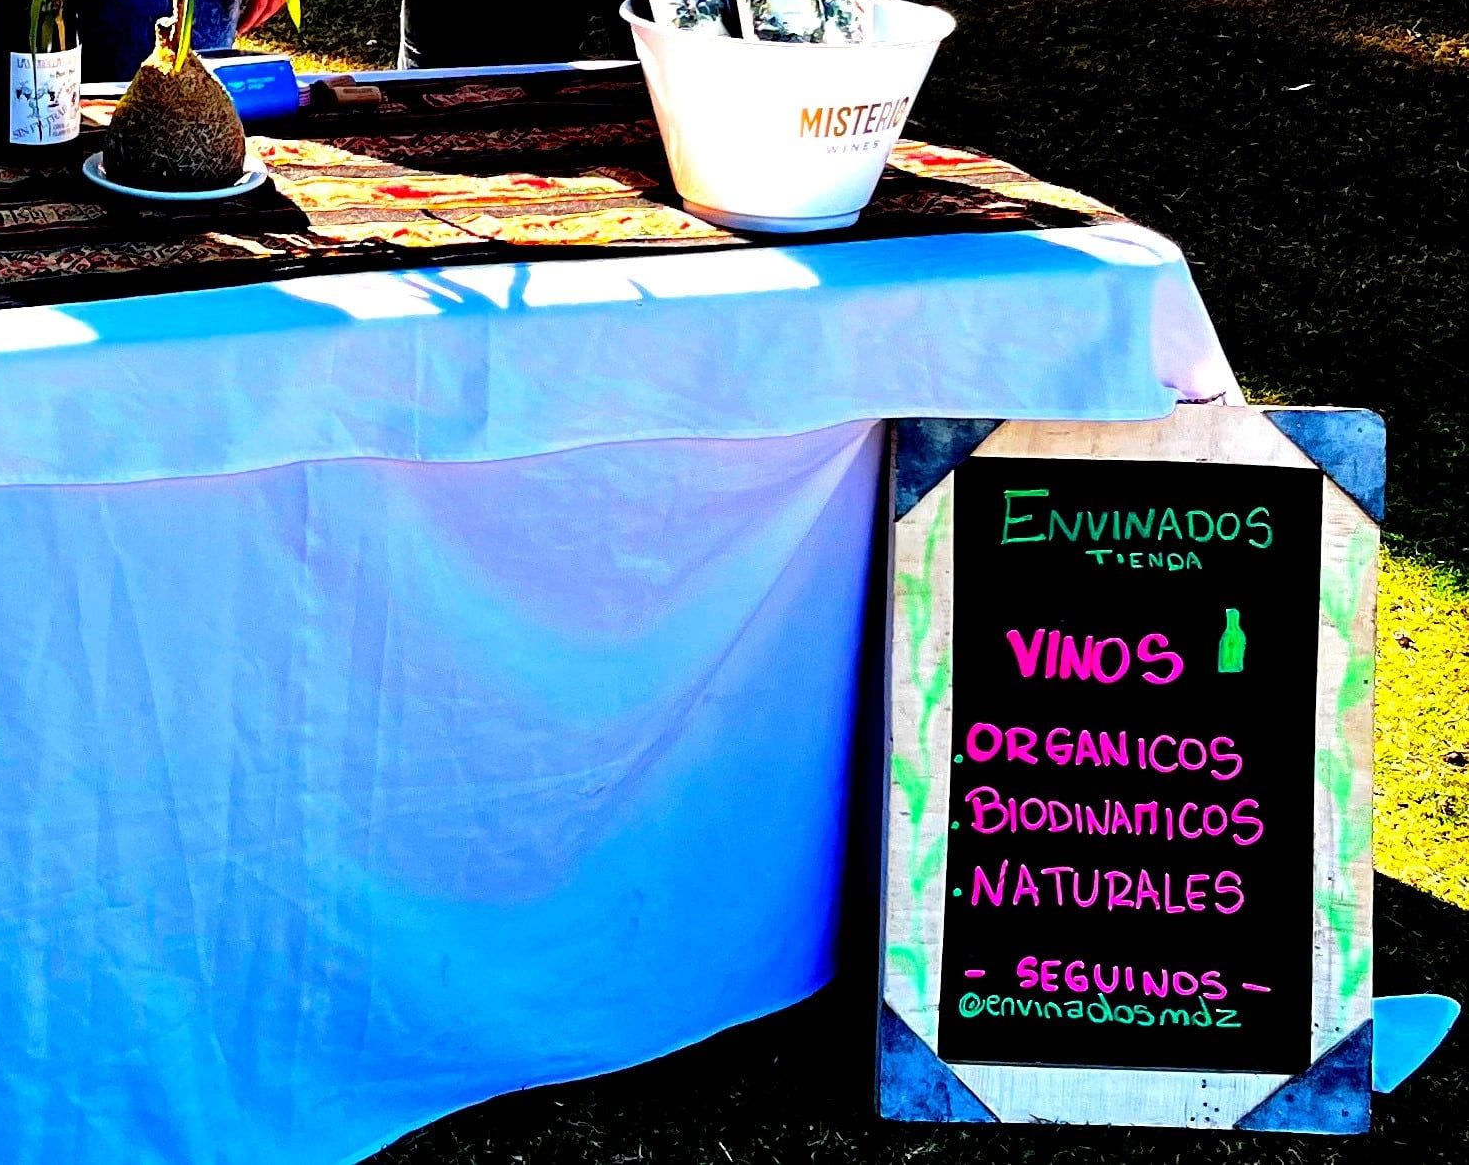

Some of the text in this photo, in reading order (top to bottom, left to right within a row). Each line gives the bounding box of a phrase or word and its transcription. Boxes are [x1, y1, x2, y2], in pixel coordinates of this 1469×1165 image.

[799, 96, 910, 138] MISTERIO
[826, 140, 881, 154] WINES
[1000, 488, 1273, 549] ENVINADOS
[1006, 627, 1185, 685] VINOS
[966, 721, 1243, 781] ORGANICOS
[965, 785, 1265, 846] BIODINAMICOS
[971, 858, 1245, 915] NATURALES
[1016, 956, 1228, 1000] SEGUINOS
[958, 991, 1242, 1028] @envinadosmdz
